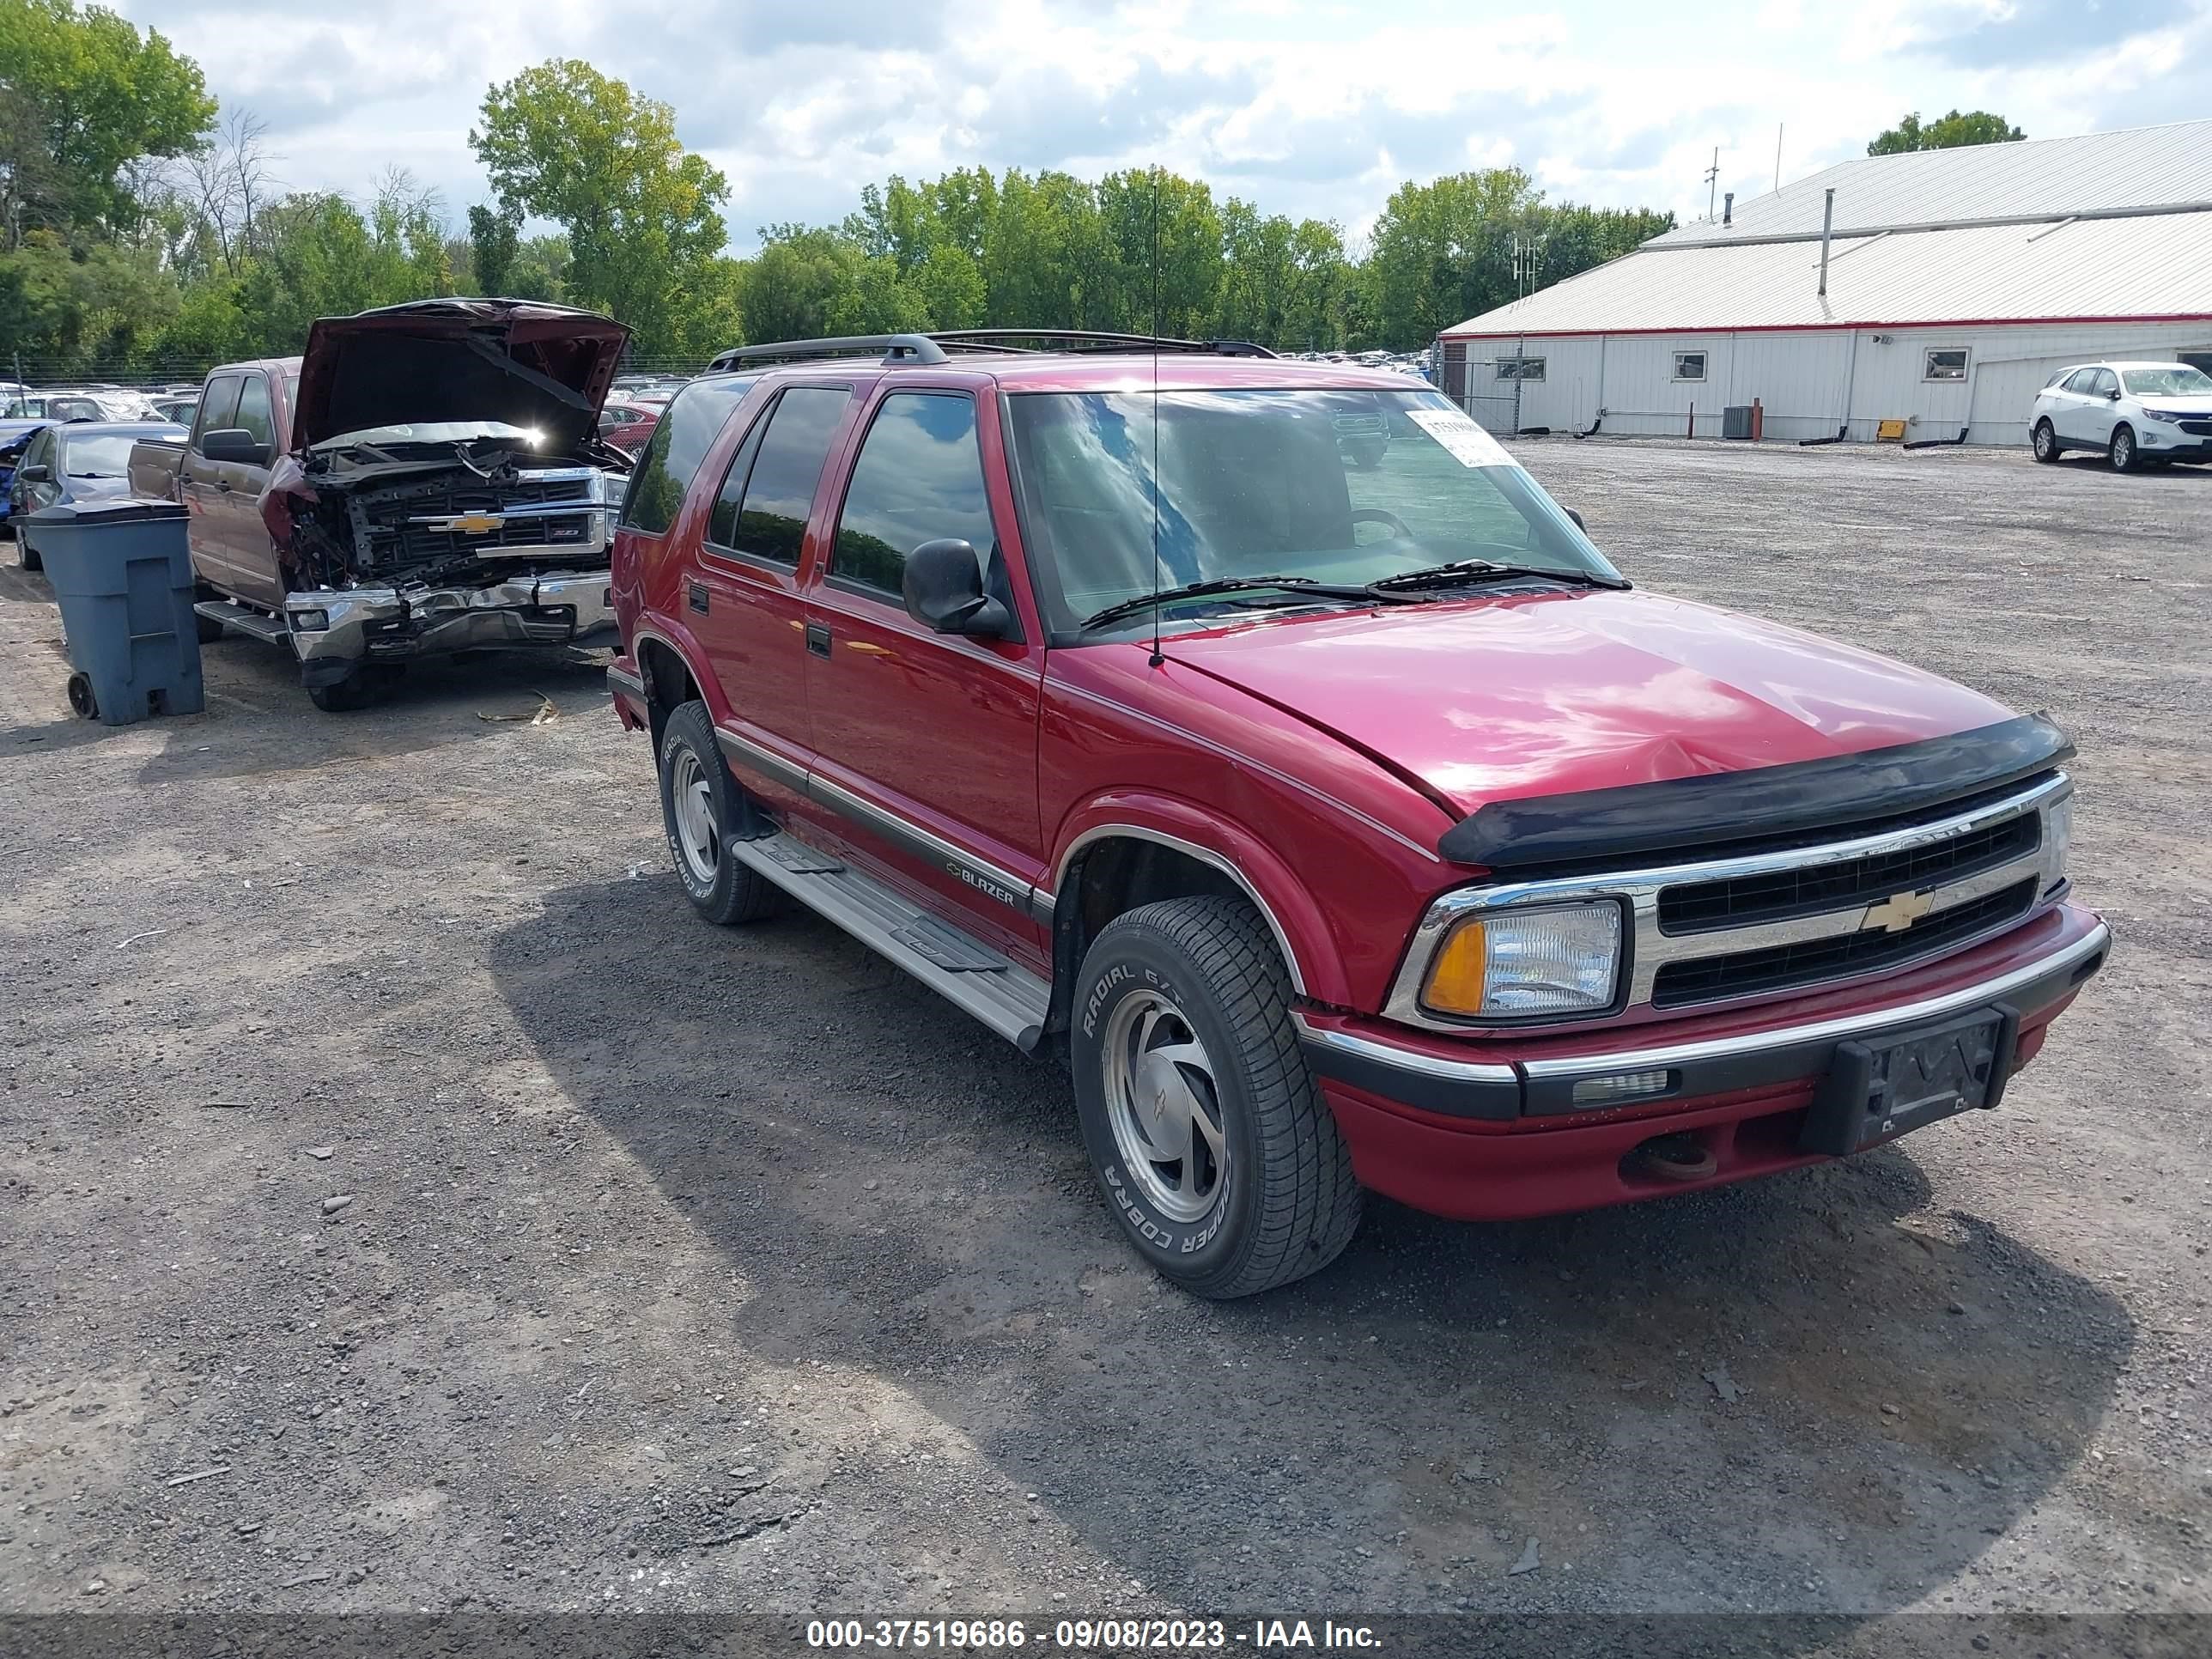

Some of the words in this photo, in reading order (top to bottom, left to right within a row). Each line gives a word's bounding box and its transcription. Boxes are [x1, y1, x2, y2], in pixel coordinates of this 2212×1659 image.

[670, 835, 696, 891] COBRA
[962, 868, 1015, 907] BLAZER
[1083, 963, 1136, 1039] RADIAL
[1103, 1164, 1174, 1250] COBRA
[1181, 1148, 1232, 1254] COOPER
